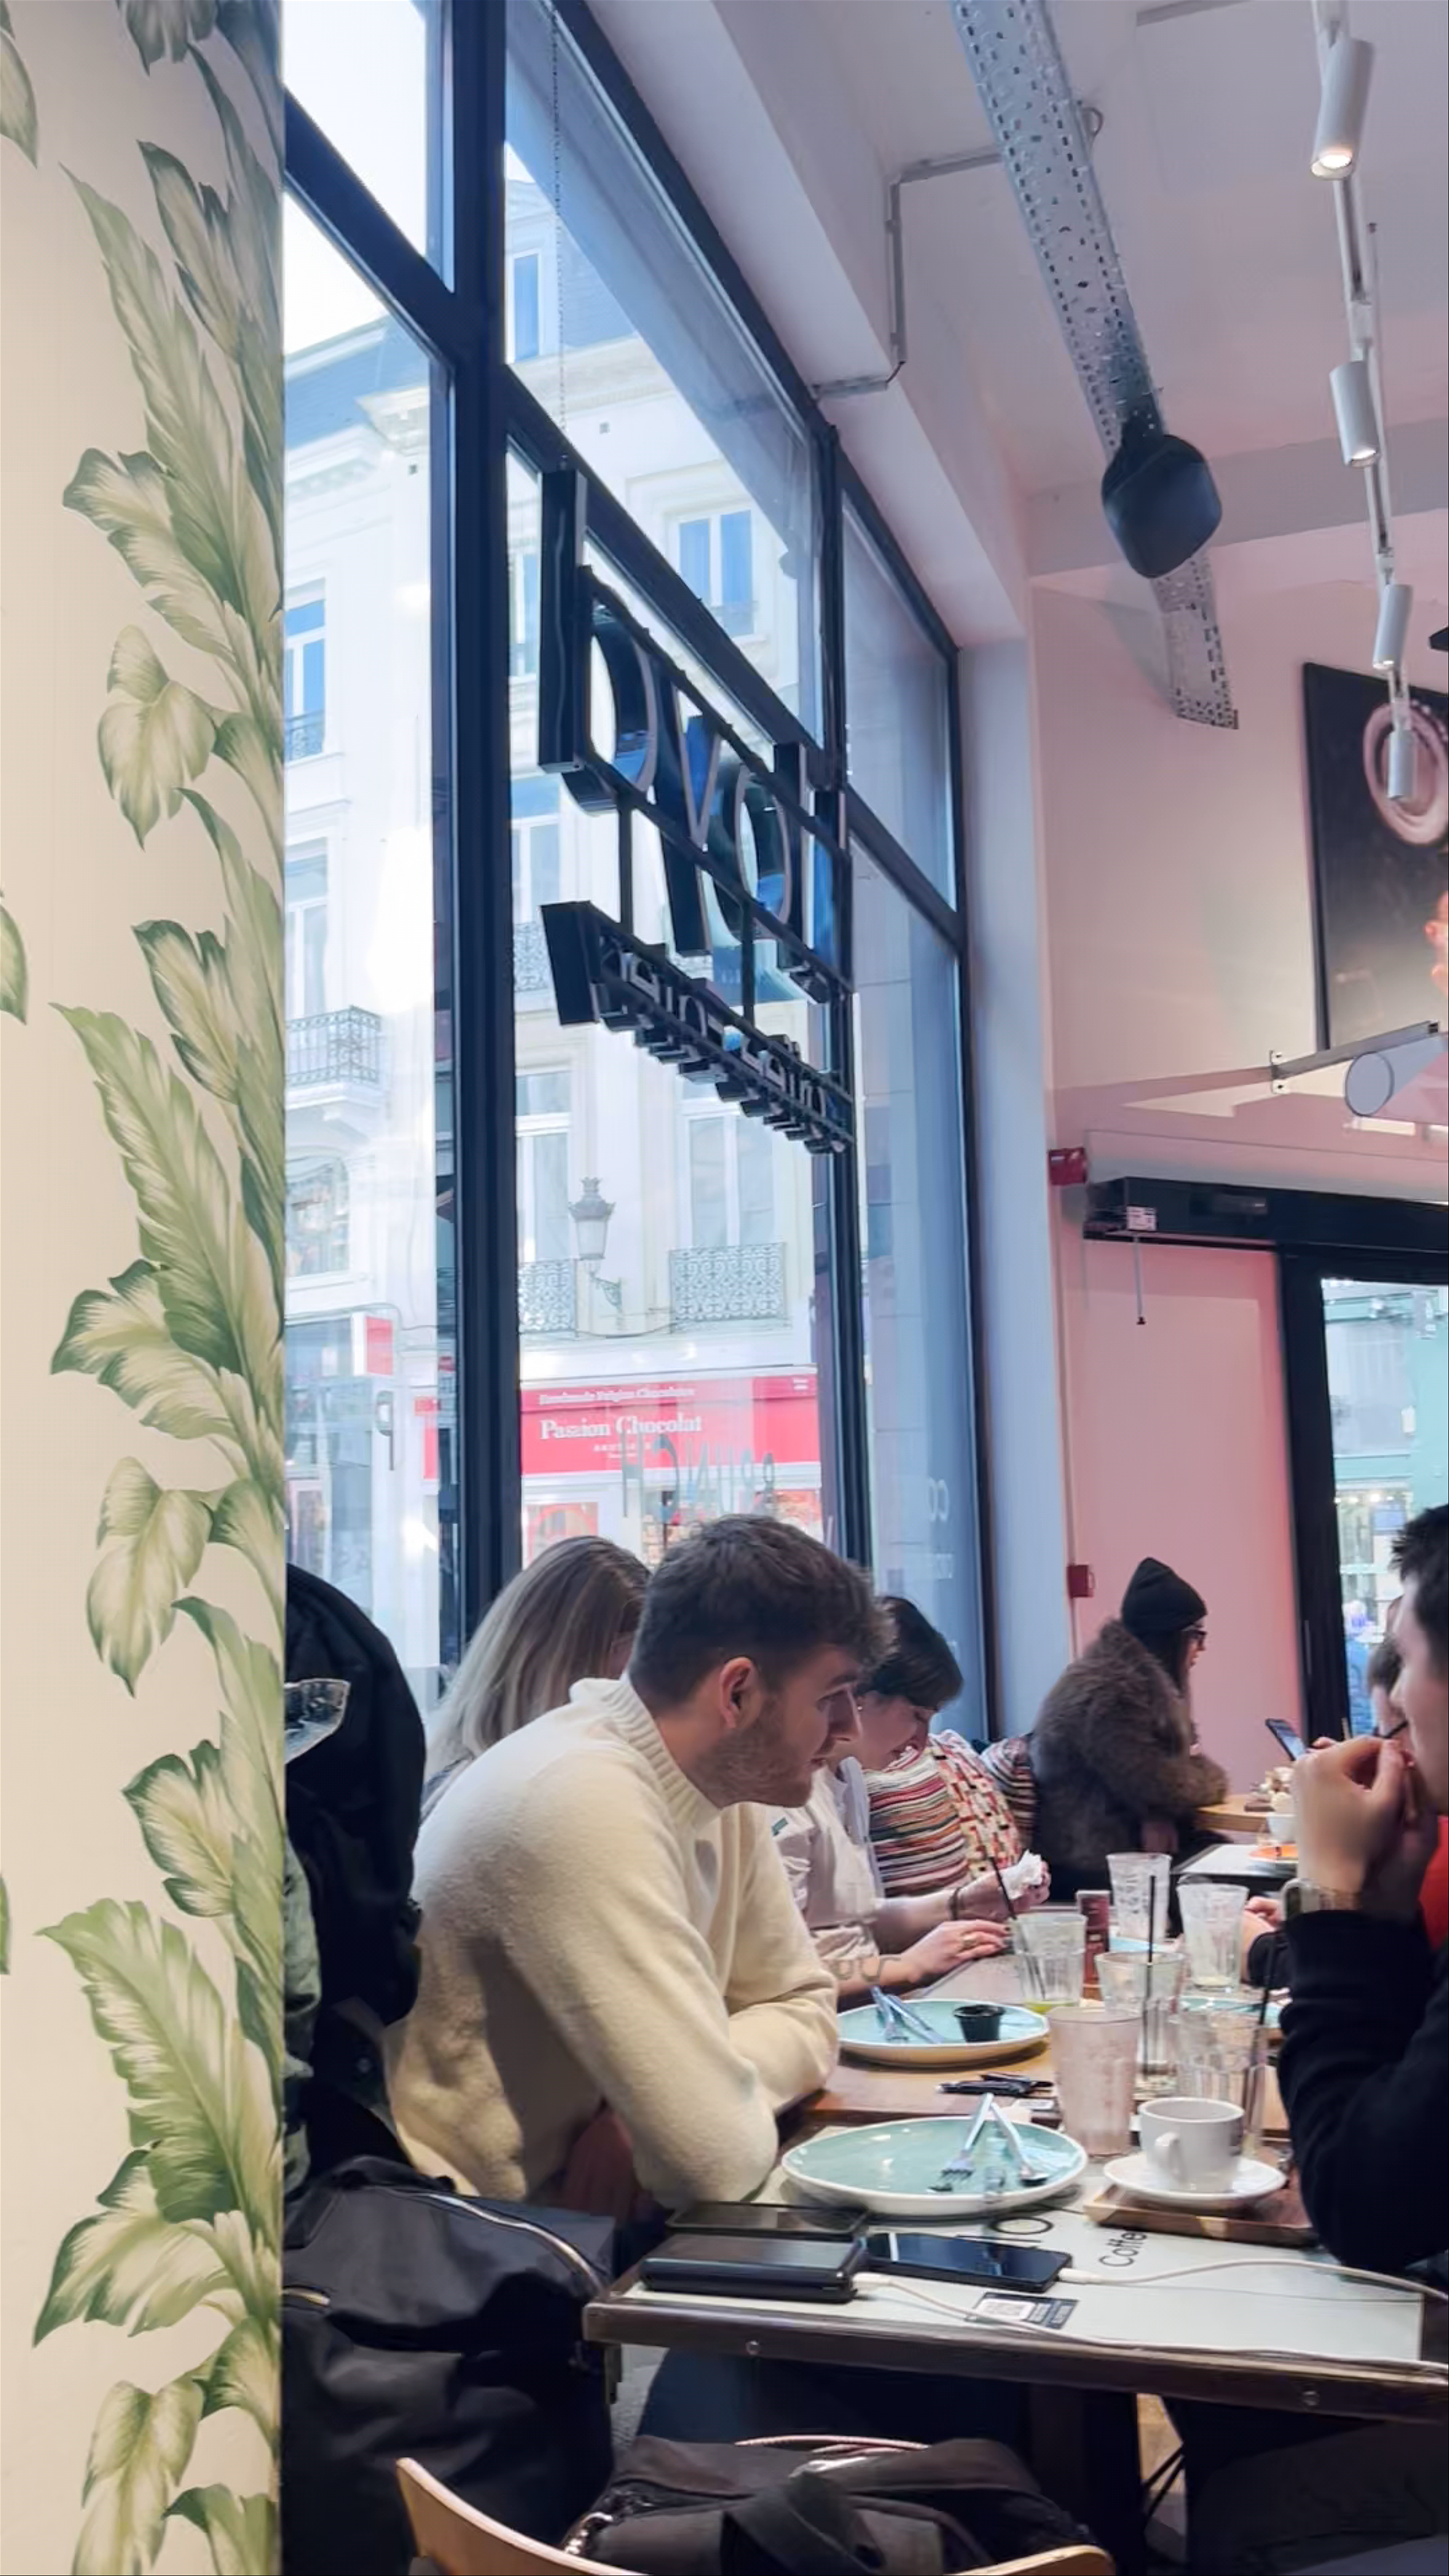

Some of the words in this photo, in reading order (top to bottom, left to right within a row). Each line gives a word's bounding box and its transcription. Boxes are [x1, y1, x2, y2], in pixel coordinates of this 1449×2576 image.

[541, 1418, 611, 1439] Passion
[616, 1412, 702, 1434] Chocolat
[1098, 2232, 1148, 2267] Coffe
